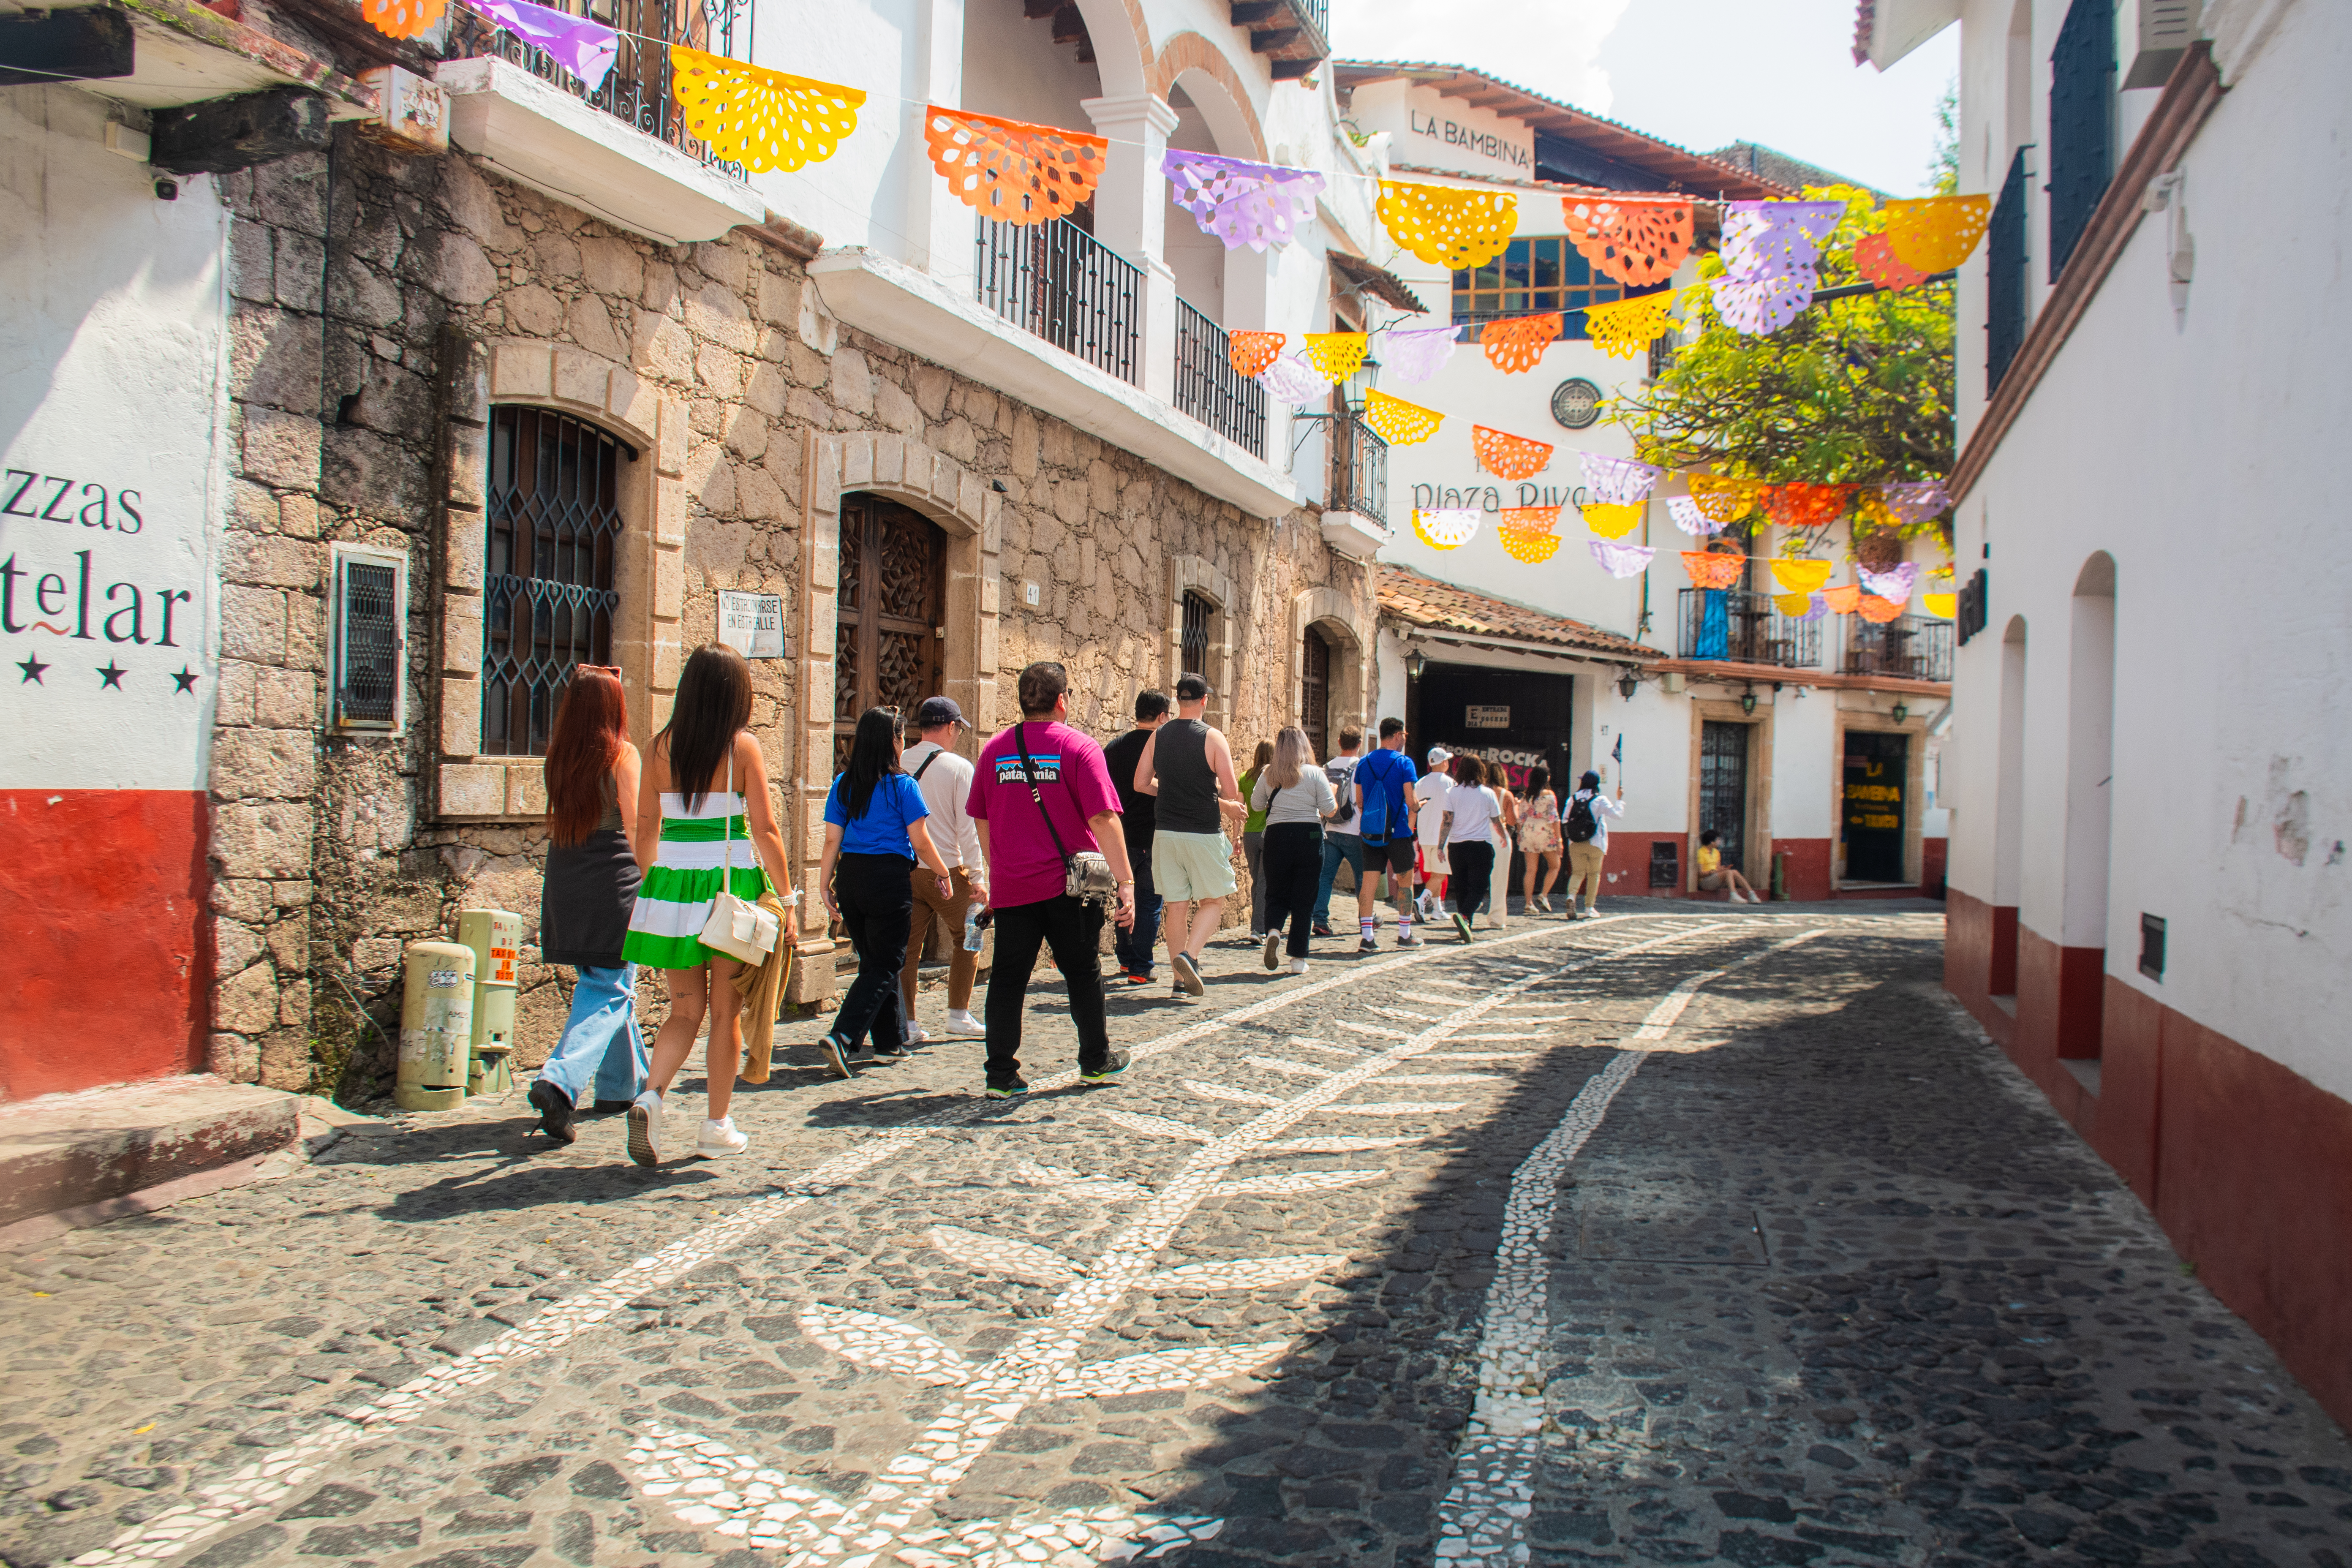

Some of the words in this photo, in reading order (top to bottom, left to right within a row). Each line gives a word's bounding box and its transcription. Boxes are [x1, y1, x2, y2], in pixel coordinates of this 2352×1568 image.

[1411, 109, 1438, 139] LA
[1445, 121, 1530, 169] BAMBINA
[2, 468, 143, 535] zzas
[1412, 483, 1501, 513] Plaza
[0, 550, 191, 647] telar
[721, 596, 729, 610] NO
[732, 597, 778, 613] ESTACIONARSE
[1028, 587, 1037, 602] 41
[728, 614, 735, 628] EN
[738, 615, 752, 629] ESTA
[754, 616, 775, 630] CALLE
